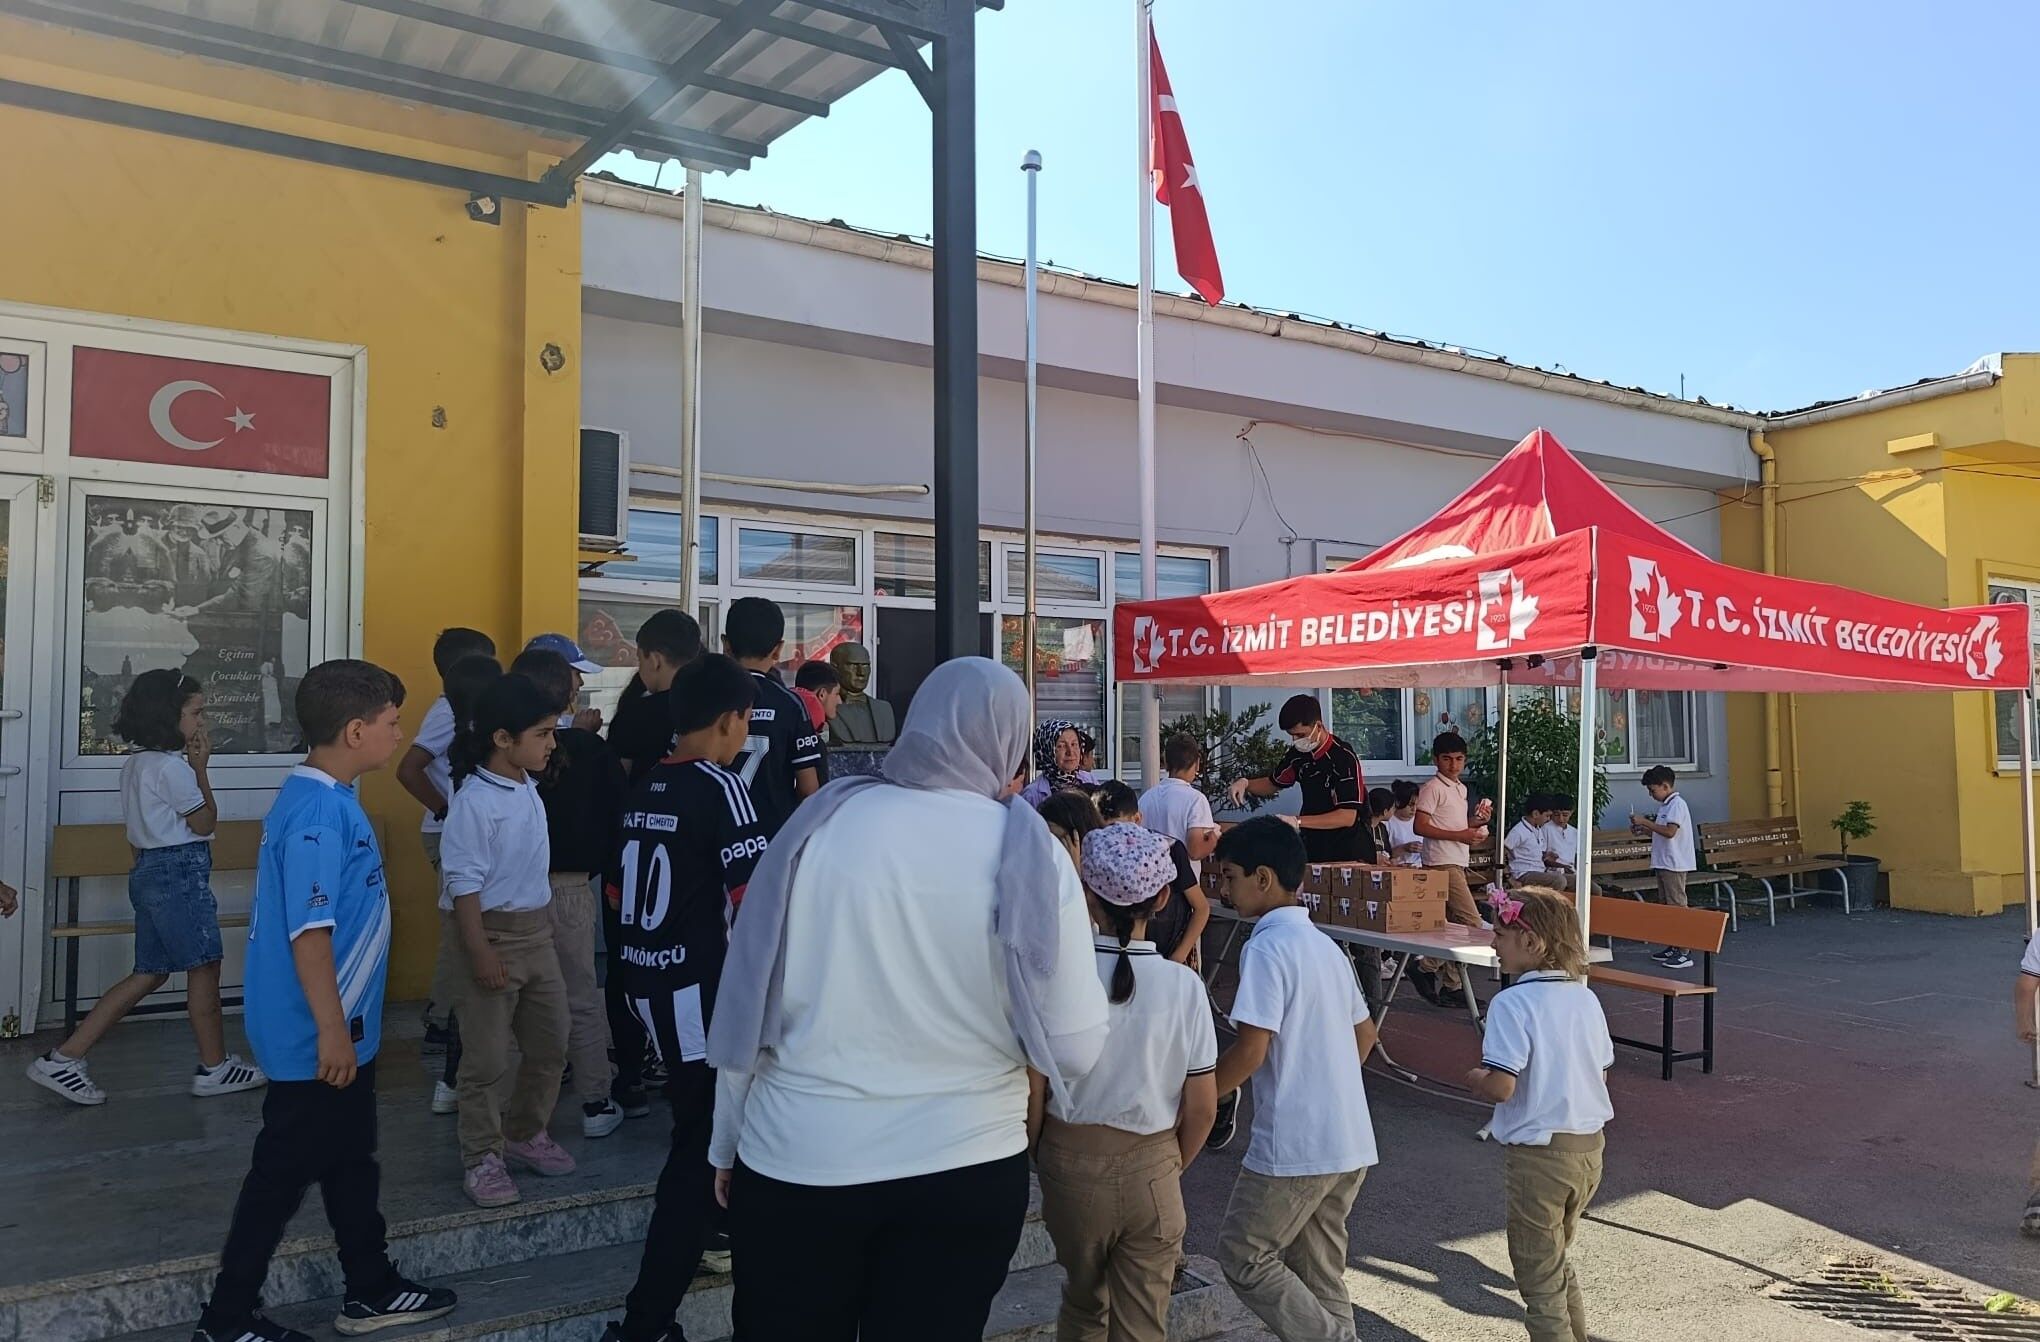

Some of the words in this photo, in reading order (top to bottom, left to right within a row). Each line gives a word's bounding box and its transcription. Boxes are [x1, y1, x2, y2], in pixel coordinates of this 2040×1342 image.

[1168, 626, 1215, 656] T.C.
[1221, 613, 1293, 654] İZMİT
[1300, 590, 1475, 647] BELEDİYESİ
[1684, 588, 1750, 635] T.C.
[1752, 596, 1831, 647] İZMİT
[1835, 619, 1972, 663] BELEDİYESİ
[796, 734, 818, 751] pap
[720, 835, 768, 868] papa
[621, 839, 672, 931] 10
